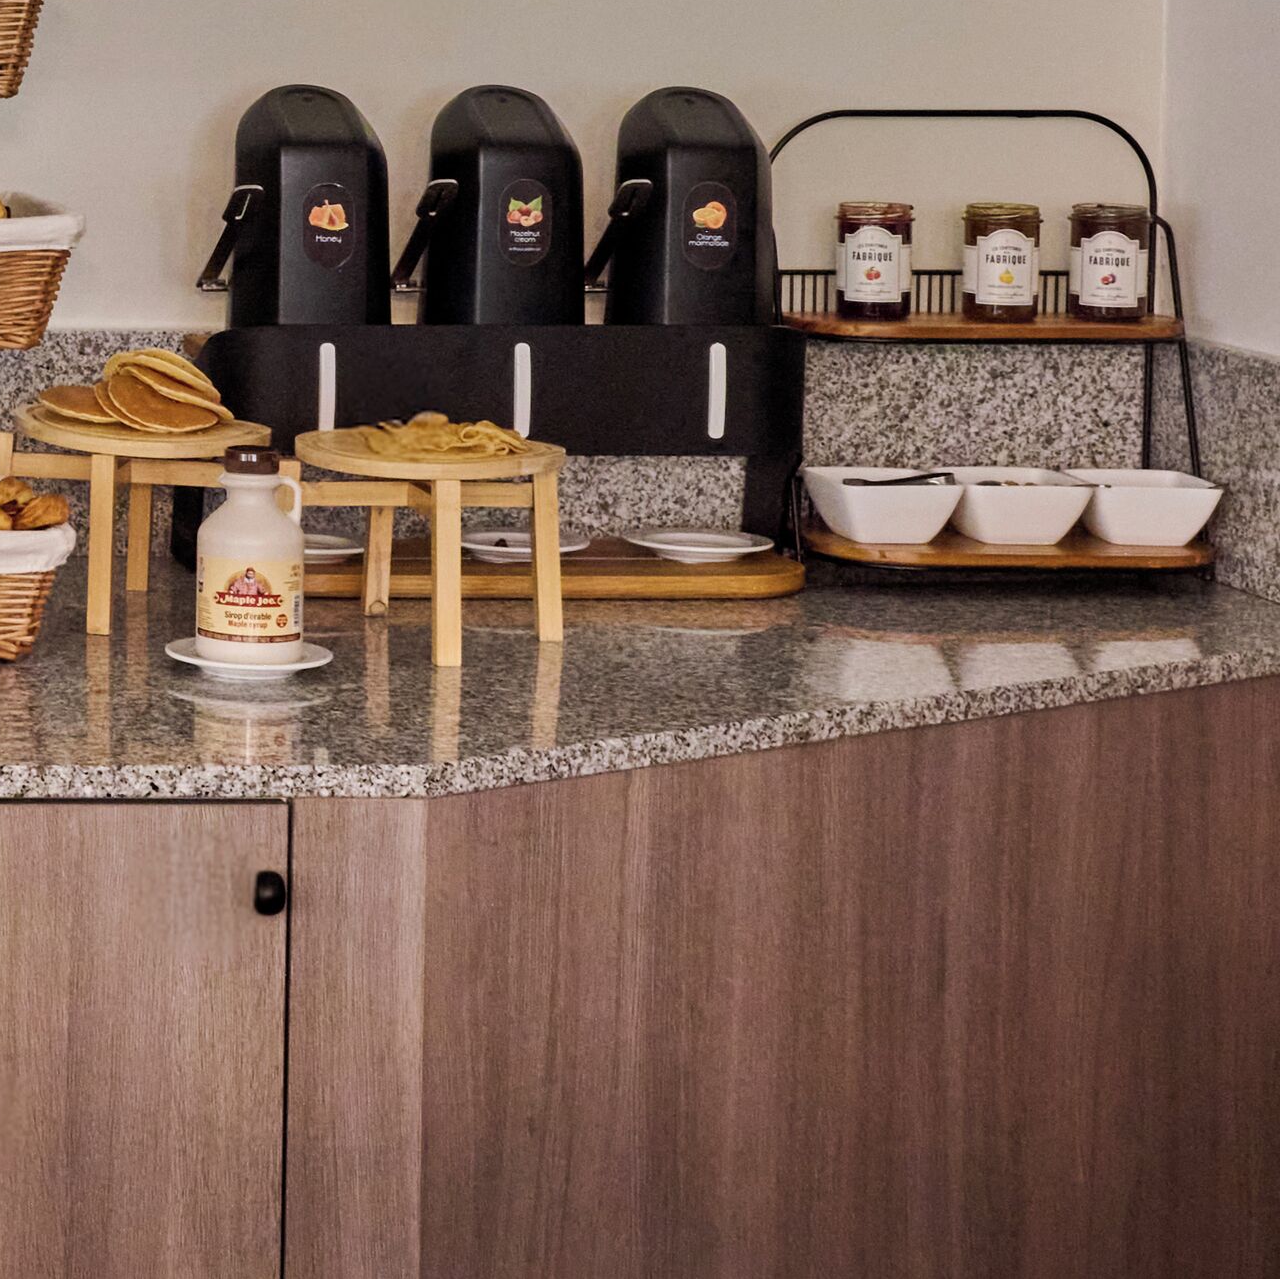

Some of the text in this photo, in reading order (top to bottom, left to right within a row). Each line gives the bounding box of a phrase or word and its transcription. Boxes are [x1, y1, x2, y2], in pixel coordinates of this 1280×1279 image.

[315, 234, 342, 244] Honey
[696, 233, 722, 242] Orange
[852, 251, 893, 262] FABRIQUE
[985, 254, 1026, 265] FABRIQUE
[1089, 255, 1130, 267] FABRIQUE
[220, 594, 256, 606] Maple
[224, 611, 242, 620] Sirop
[228, 620, 247, 628] Maple
